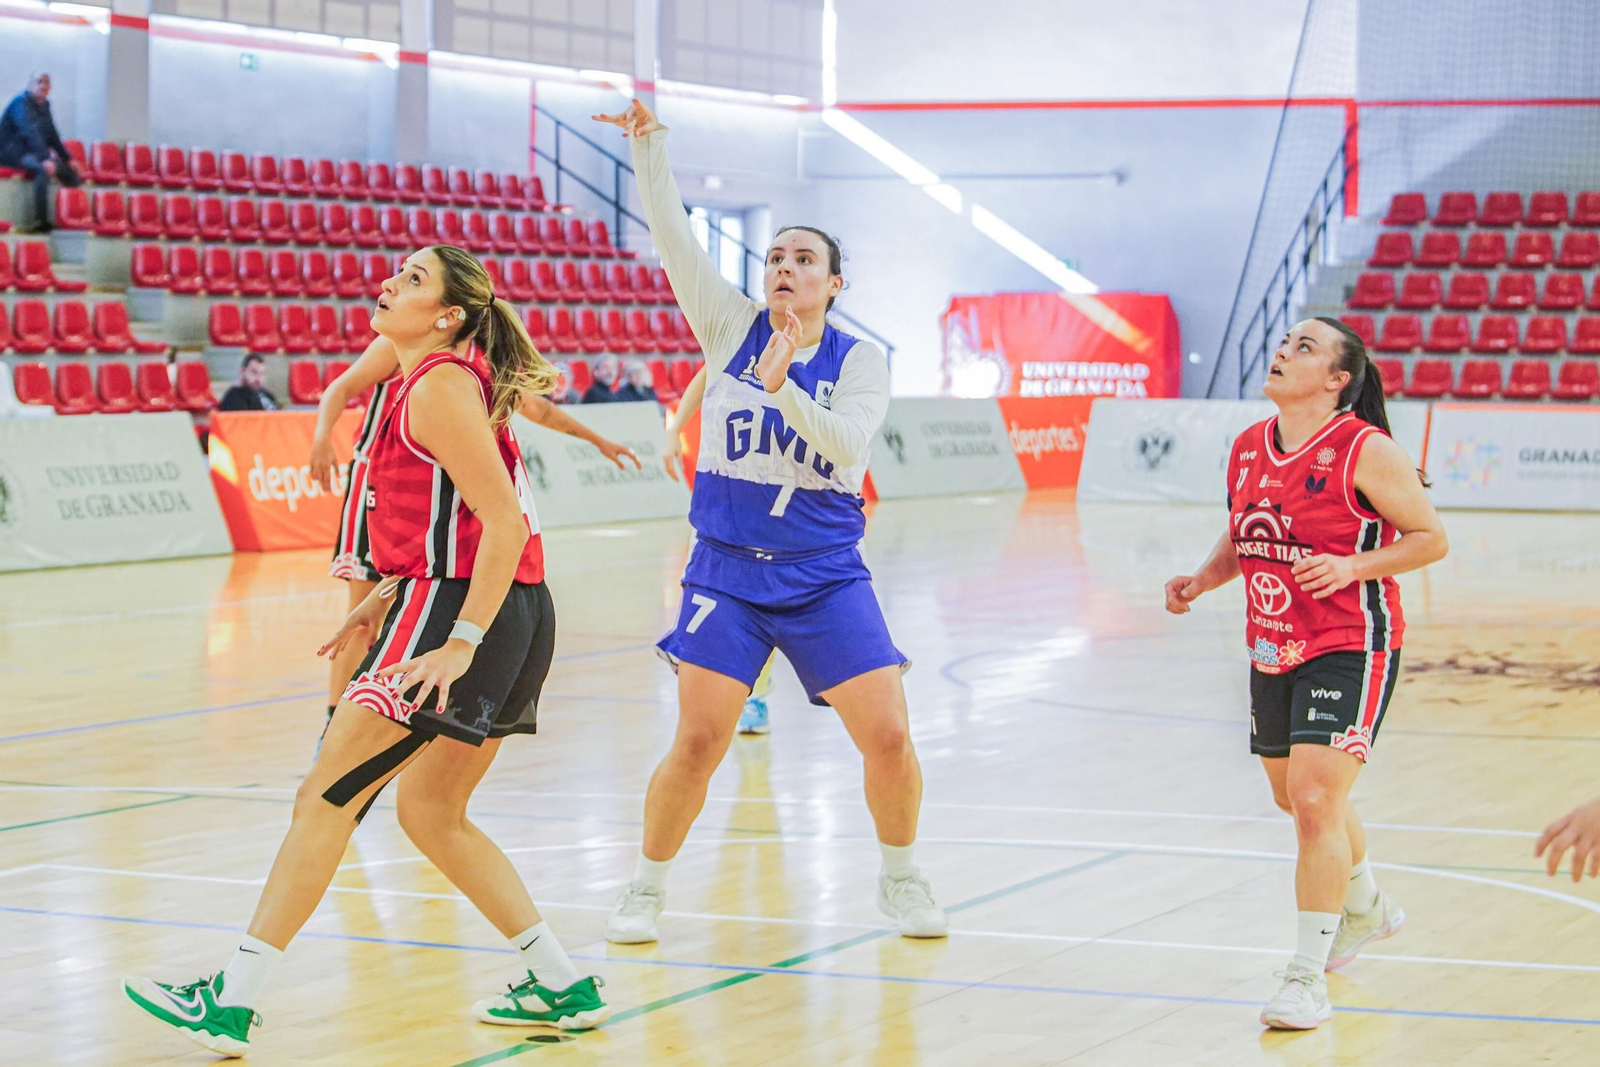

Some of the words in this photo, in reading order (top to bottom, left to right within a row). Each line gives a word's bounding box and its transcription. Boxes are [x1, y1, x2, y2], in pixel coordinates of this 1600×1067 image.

[1022, 361, 1151, 380] UNIVERSIDAD
[46, 460, 181, 488] UNIVERSIDAD
[767, 474, 796, 517] 7
[685, 592, 718, 635] 7
